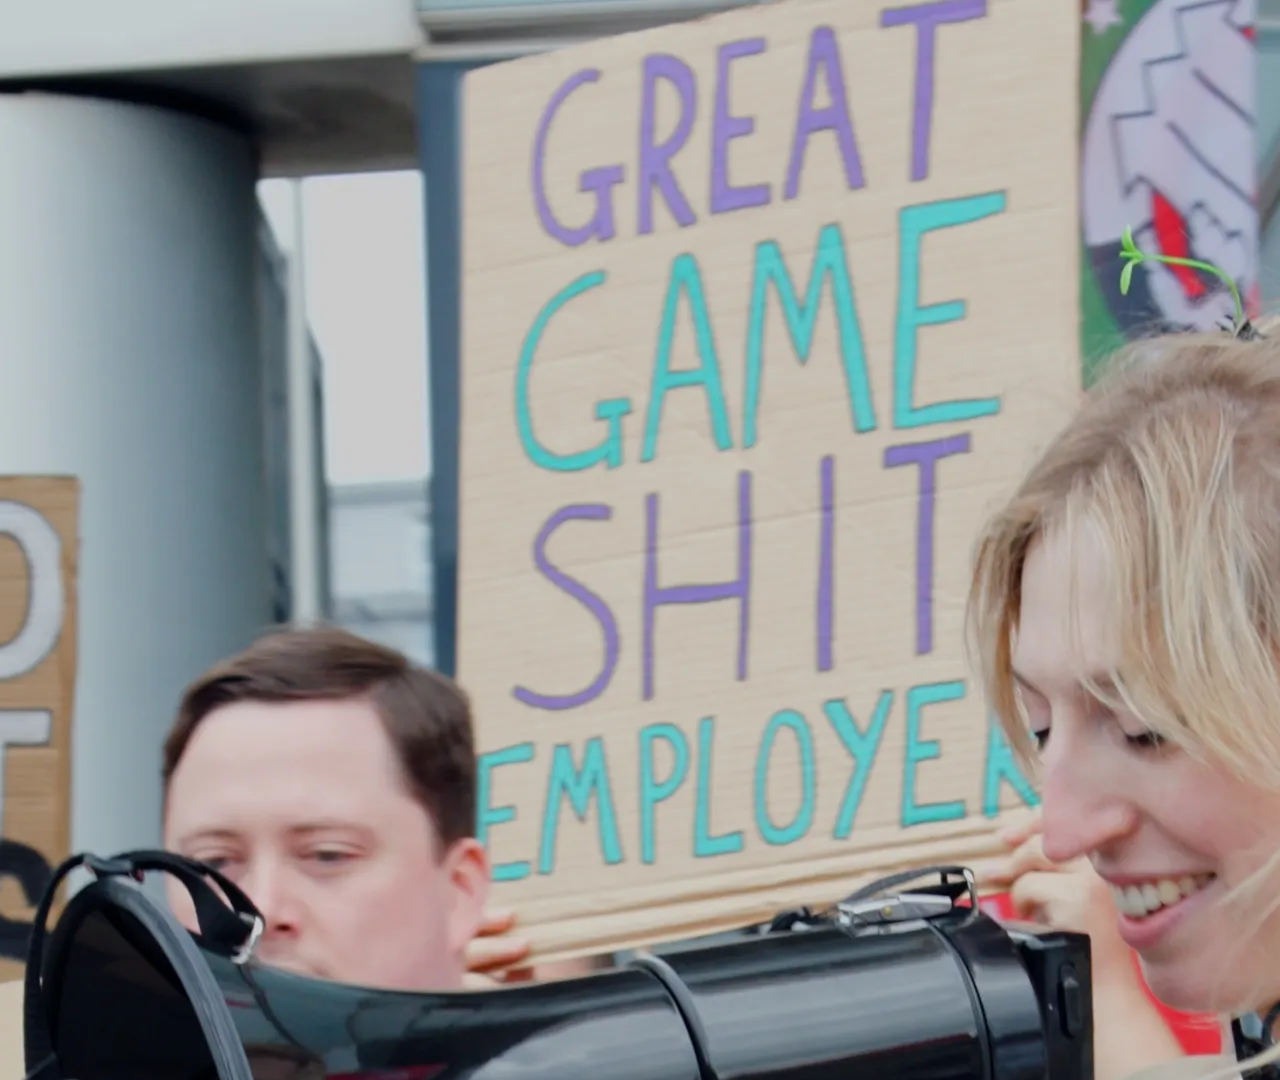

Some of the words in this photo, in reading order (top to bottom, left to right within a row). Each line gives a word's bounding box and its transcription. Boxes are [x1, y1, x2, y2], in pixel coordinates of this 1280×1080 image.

[532, 0, 988, 246] GREAT
[515, 190, 1007, 471] GAME
[513, 432, 971, 710] SHIT
